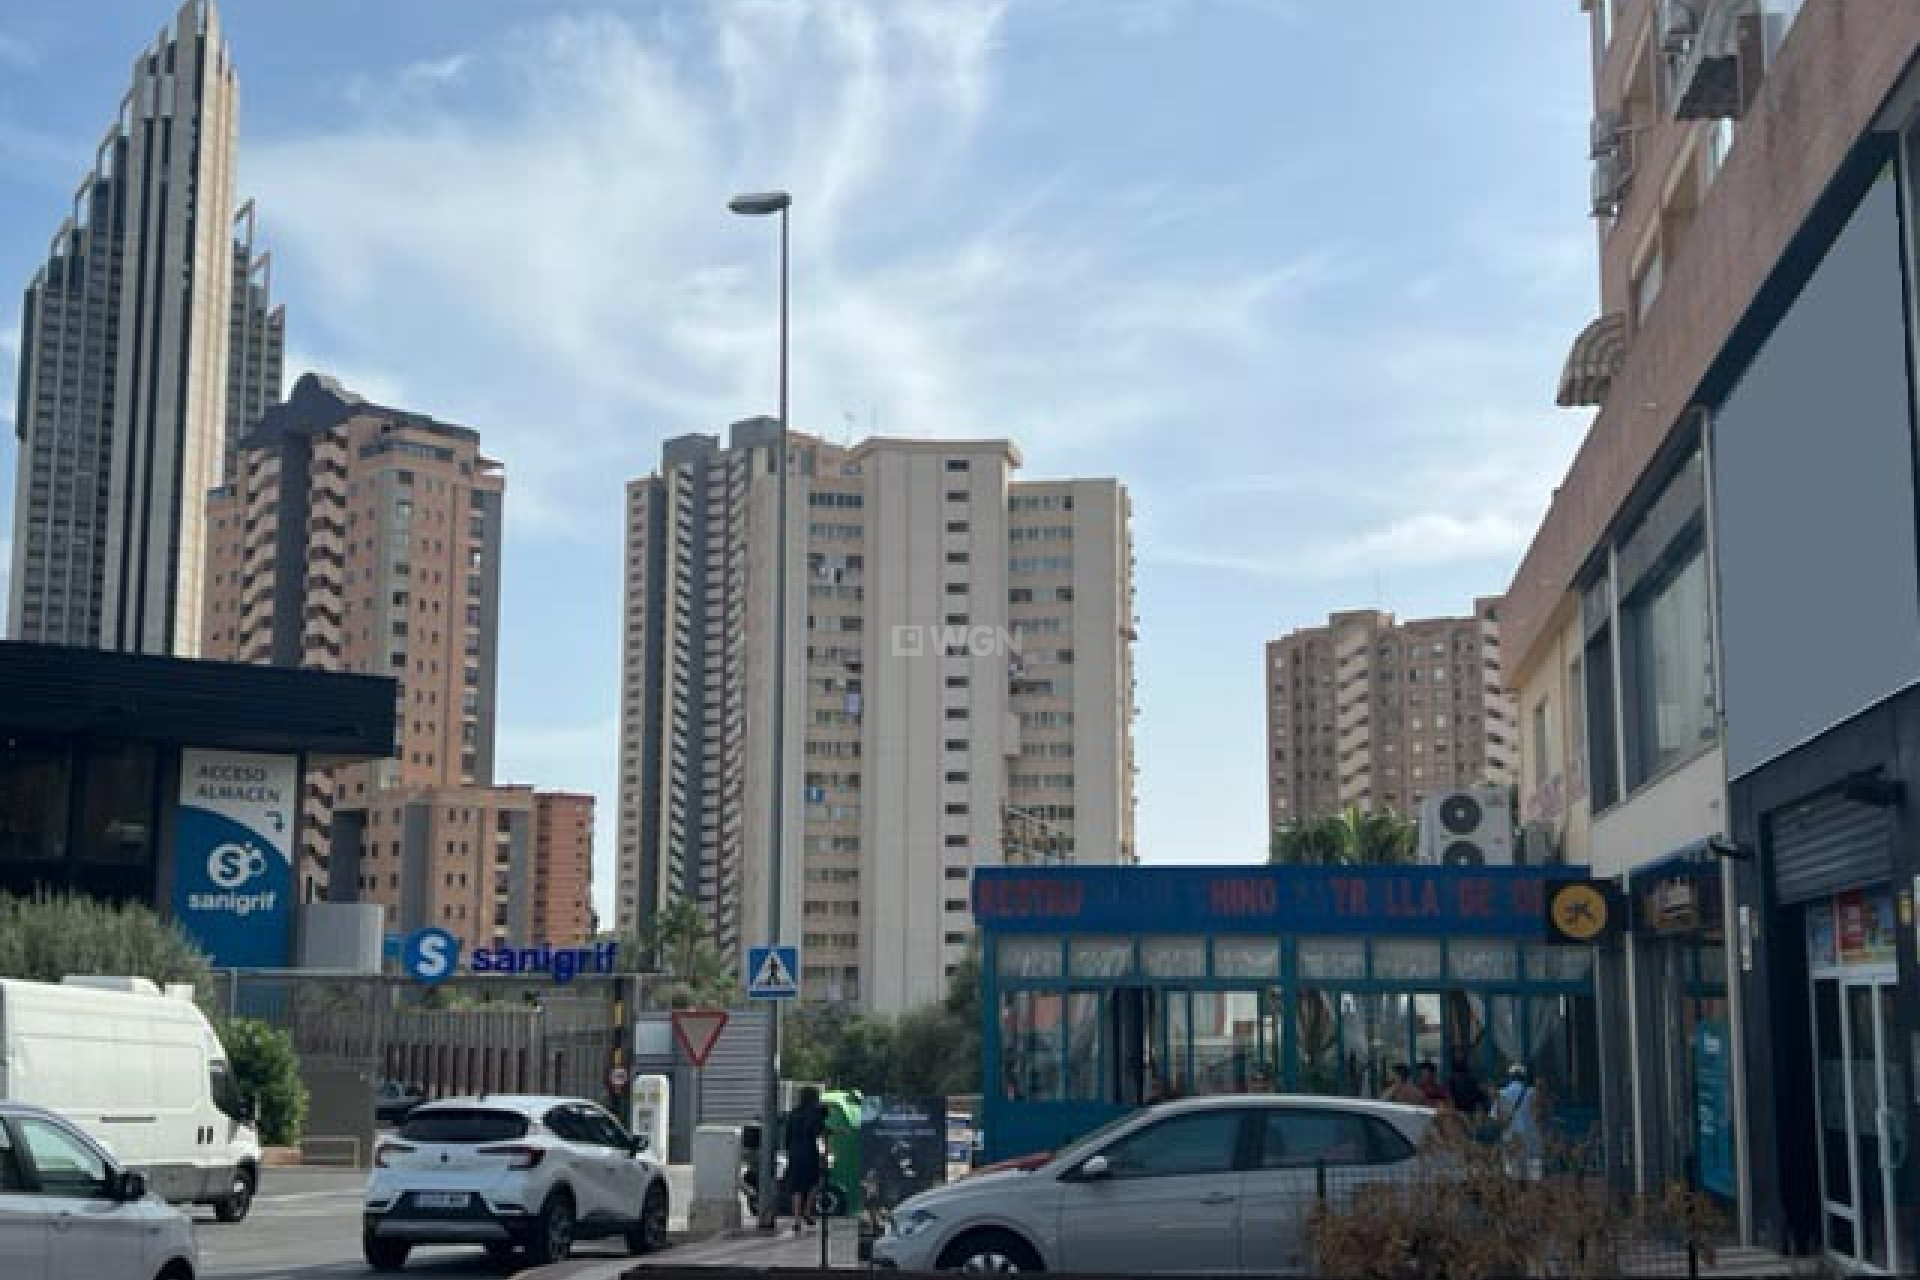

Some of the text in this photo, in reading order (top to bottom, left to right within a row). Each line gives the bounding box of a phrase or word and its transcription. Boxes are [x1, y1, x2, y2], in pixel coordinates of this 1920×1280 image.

[195, 765, 267, 782] ACCESO
[188, 892, 276, 917] sanigrif
[415, 933, 619, 985] S sanigrif
